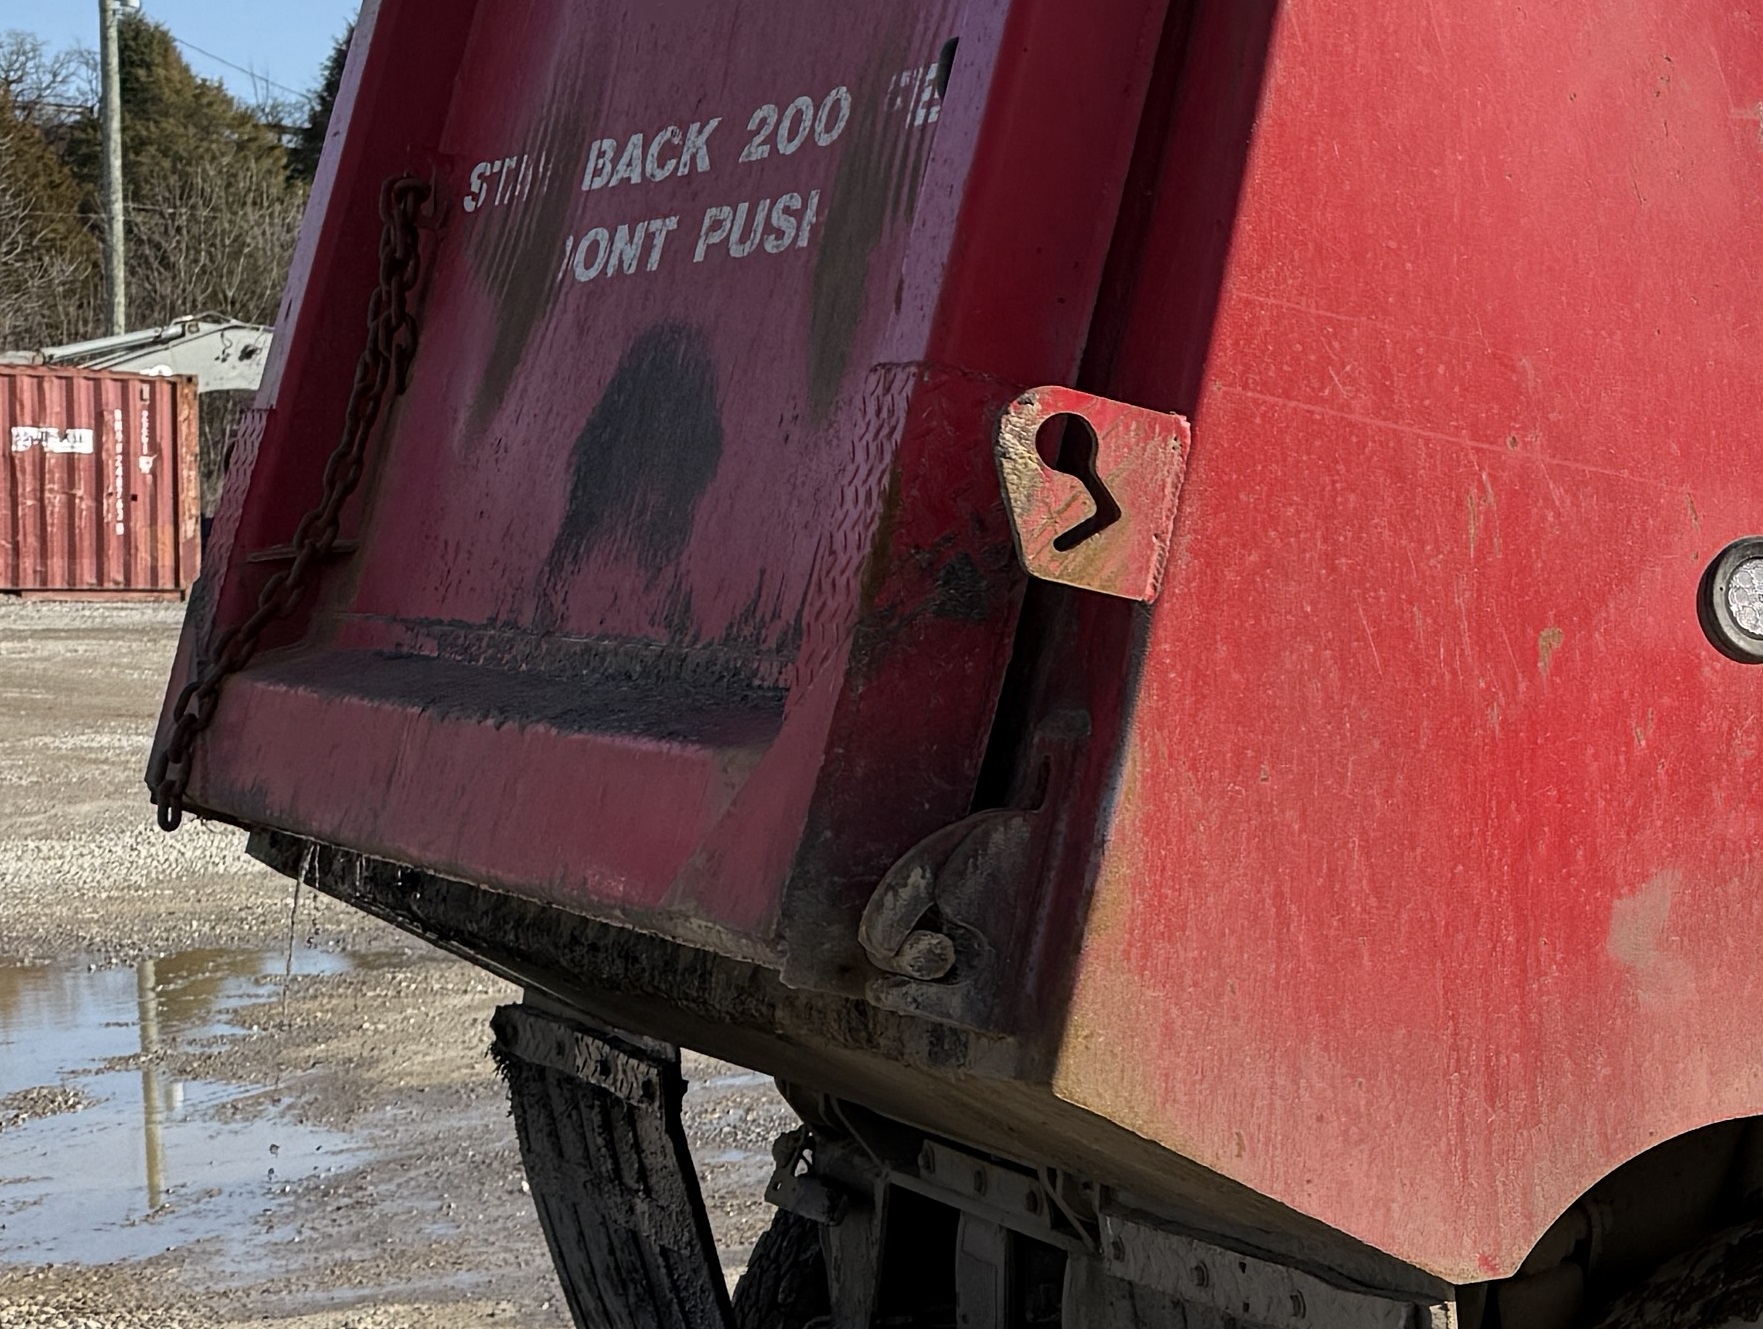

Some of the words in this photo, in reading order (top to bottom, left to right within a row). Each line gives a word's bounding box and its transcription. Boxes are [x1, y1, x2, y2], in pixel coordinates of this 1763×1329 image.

[580, 115, 722, 191] BACK
[739, 86, 852, 163] 200
[557, 215, 680, 283] ONT
